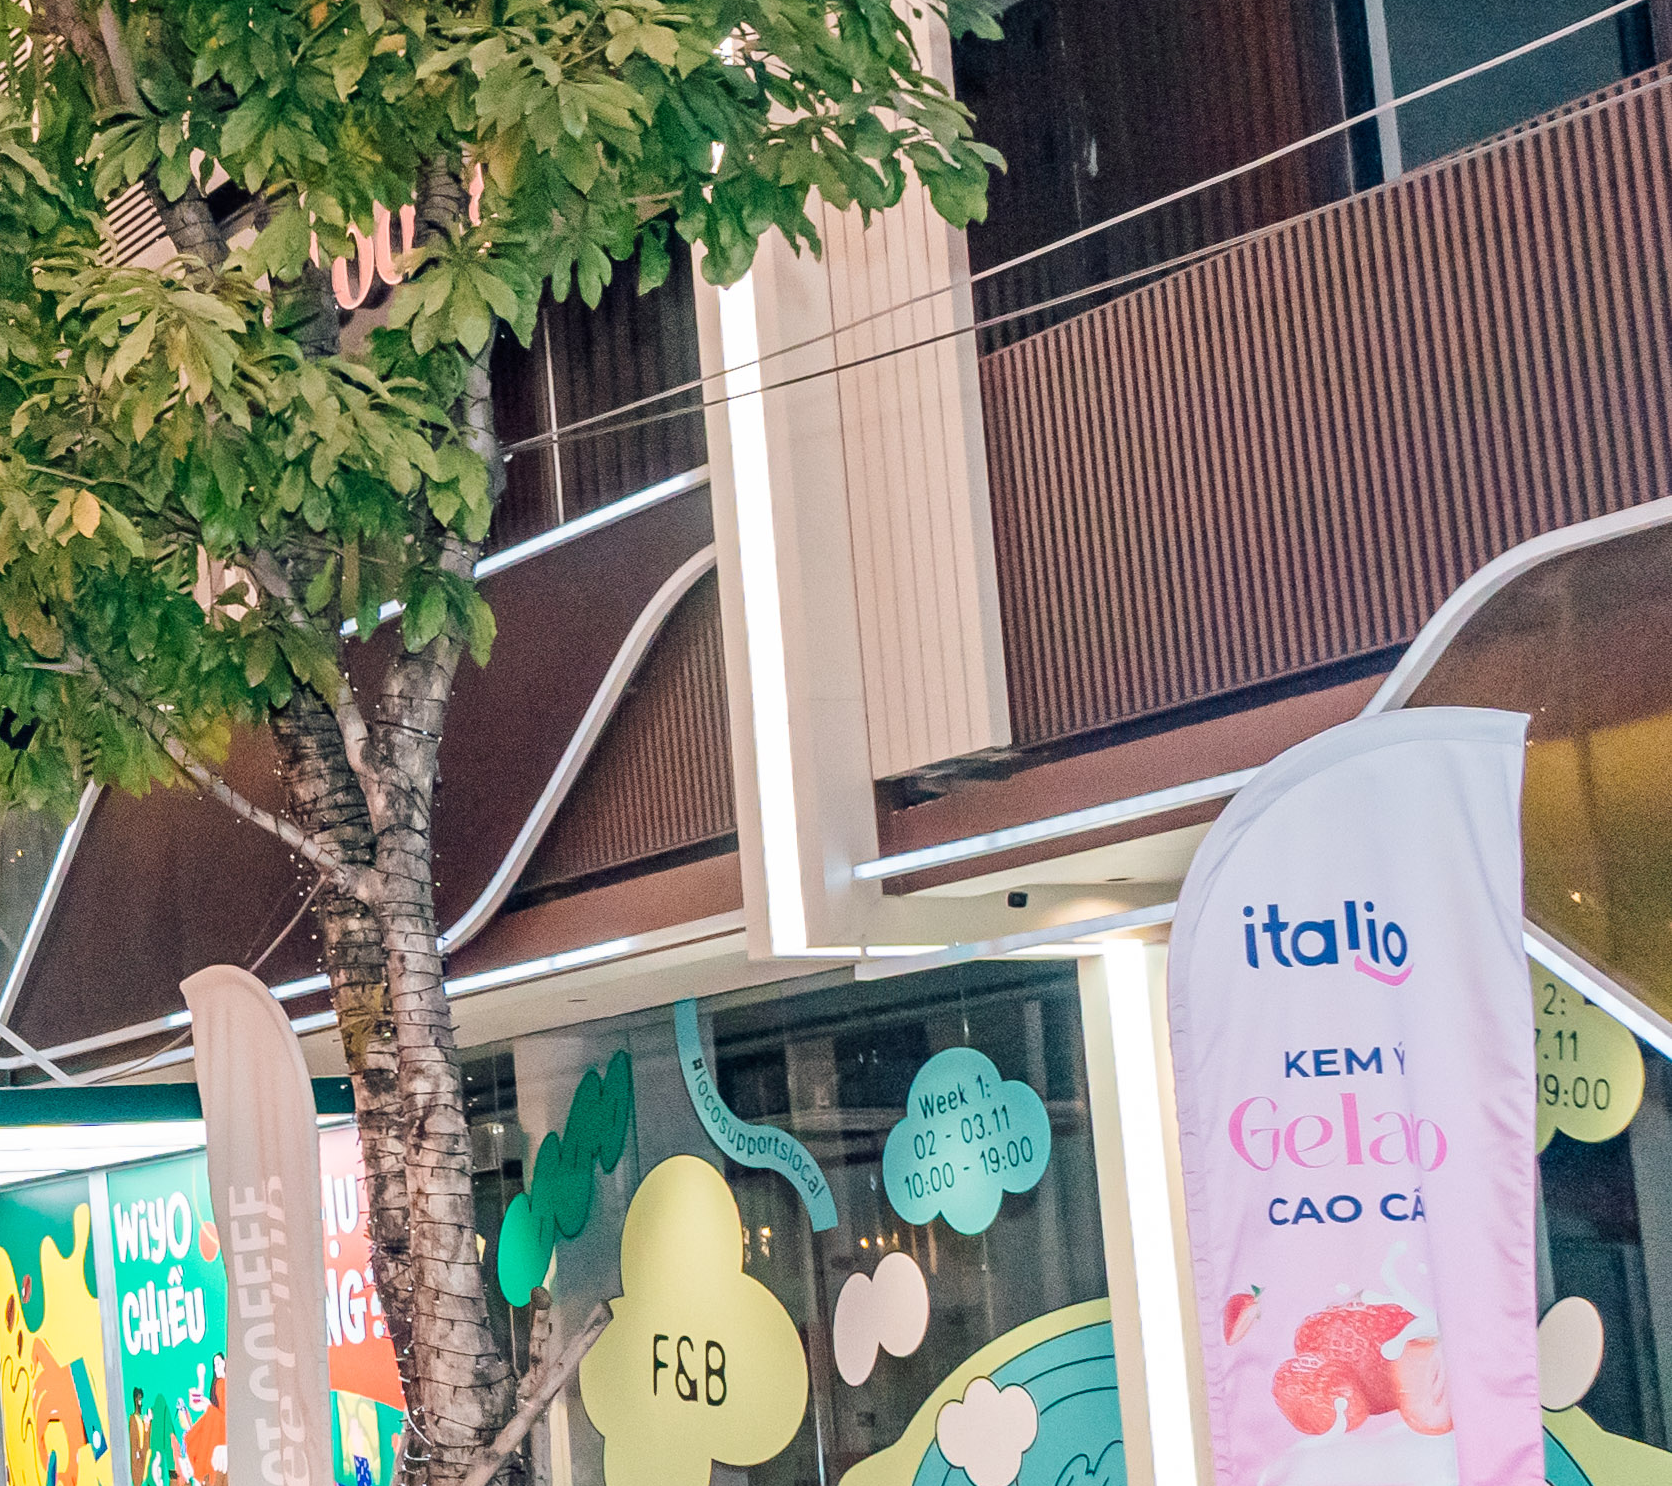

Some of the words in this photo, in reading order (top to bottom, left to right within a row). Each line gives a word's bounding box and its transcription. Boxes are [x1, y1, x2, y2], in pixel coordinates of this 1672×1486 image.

[1243, 900, 1408, 970] italio
[1284, 1046, 1383, 1078] KEM
[919, 1082, 970, 1120] Week
[913, 1129, 937, 1161] 02
[960, 1104, 1011, 1145] 03.11
[1228, 1092, 1448, 1173] Gelao
[904, 1161, 955, 1201] 10:00
[979, 1135, 1034, 1176] 19:00
[1268, 1194, 1363, 1226] CAO
[653, 1334, 727, 1407] F&B
